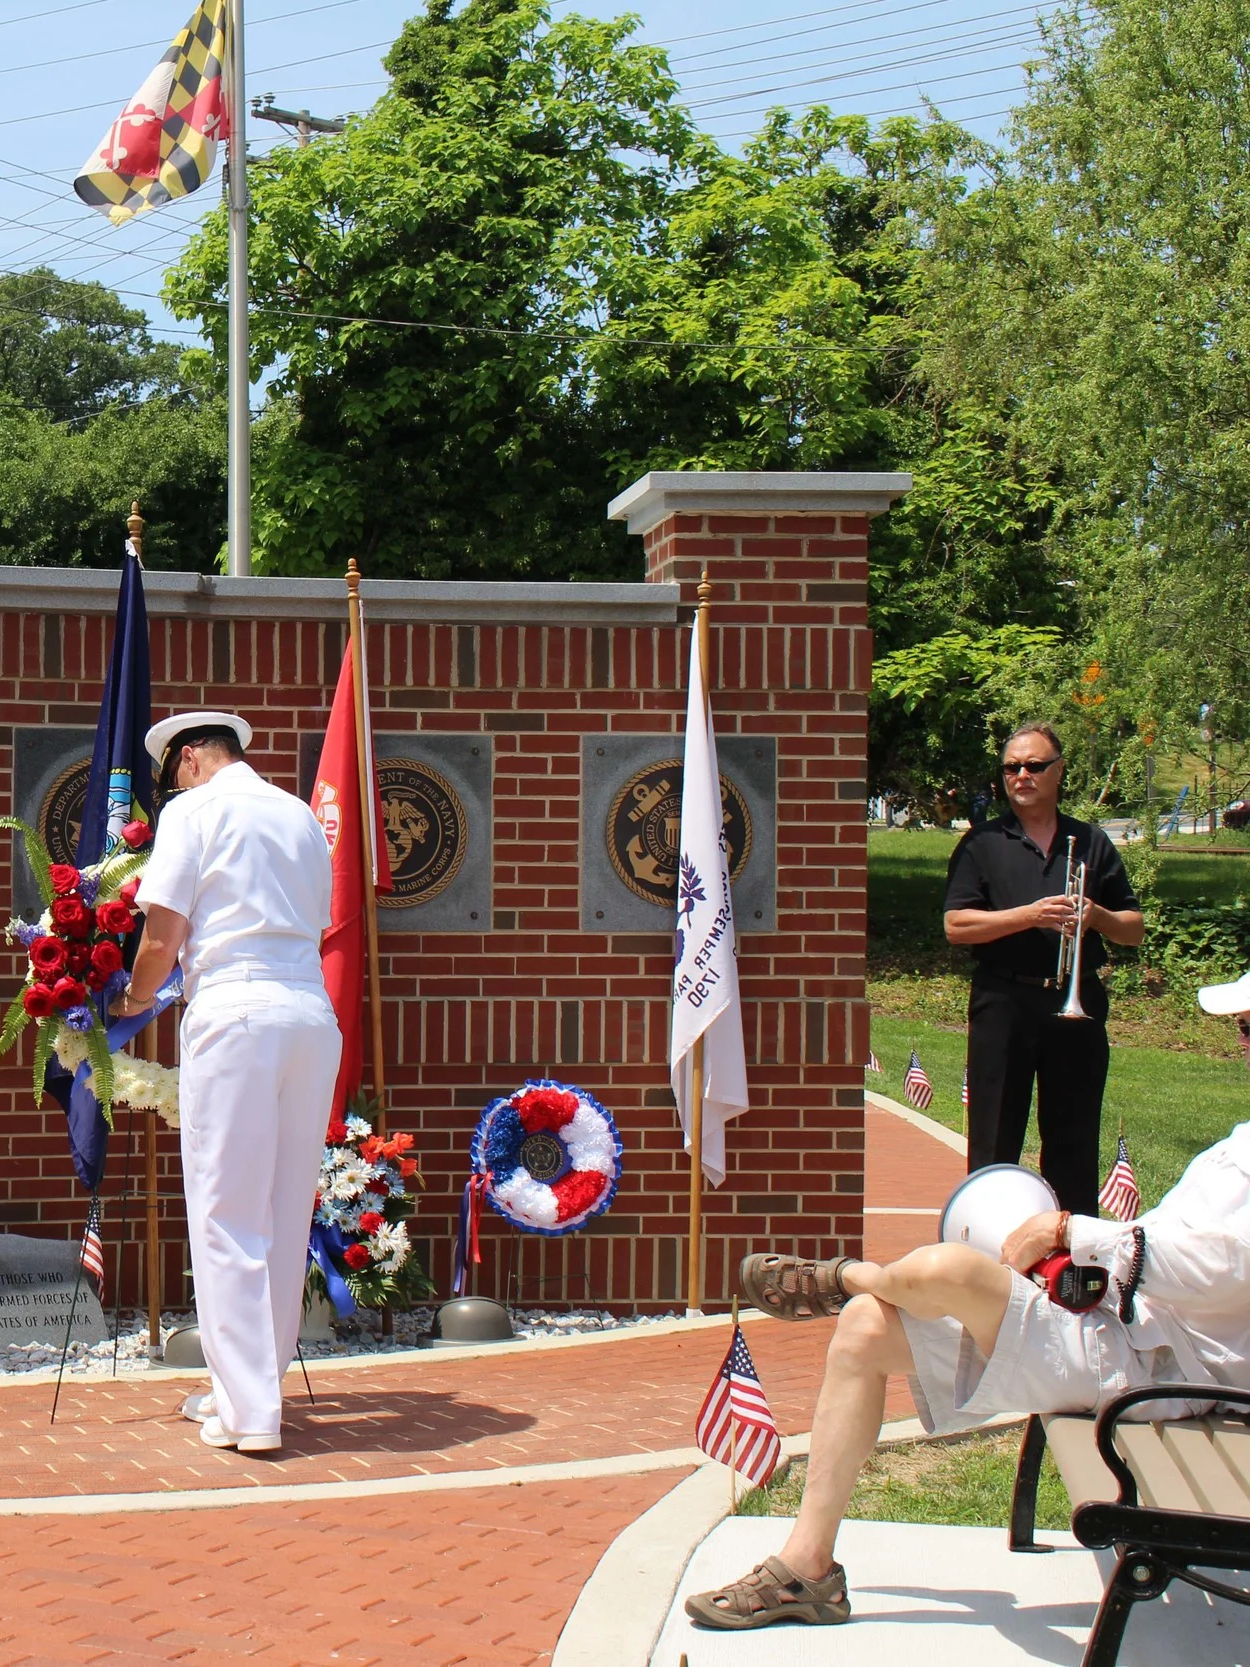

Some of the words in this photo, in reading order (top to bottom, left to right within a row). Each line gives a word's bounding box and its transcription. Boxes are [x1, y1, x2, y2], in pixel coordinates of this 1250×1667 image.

[52, 770, 91, 821] DEPARTM
[408, 777, 423, 787] OF
[423, 783, 440, 800] THE
[437, 800, 456, 838] NAVY
[52, 836, 71, 866] UNIT
[646, 823, 668, 862] UNITED
[398, 873, 433, 893] MARINE
[431, 847, 451, 876] CORPS
[0, 1272, 35, 1286] THOSE
[38, 1271, 64, 1284] WHO
[33, 1293, 73, 1306] FORCES
[75, 1292, 88, 1304] OF
[25, 1315, 38, 1328] OF
